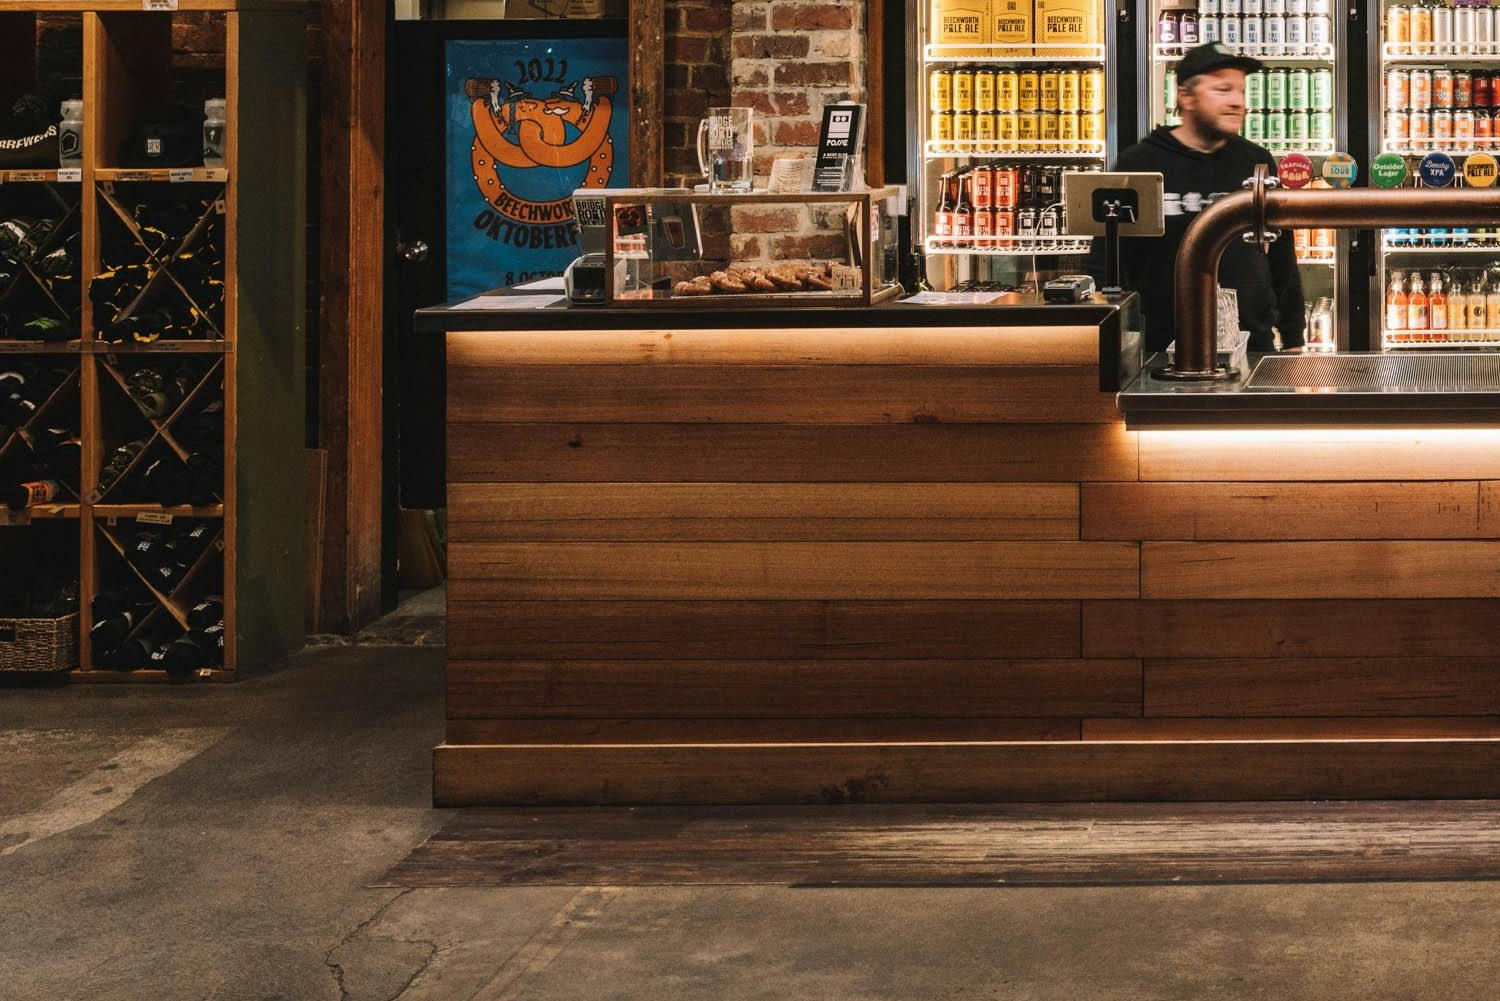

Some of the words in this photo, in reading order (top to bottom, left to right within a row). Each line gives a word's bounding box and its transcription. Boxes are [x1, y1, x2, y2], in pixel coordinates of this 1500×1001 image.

[514, 57, 568, 84] 2022
[496, 192, 574, 222] BEECHWOR
[474, 209, 579, 249] OKTOBERF
